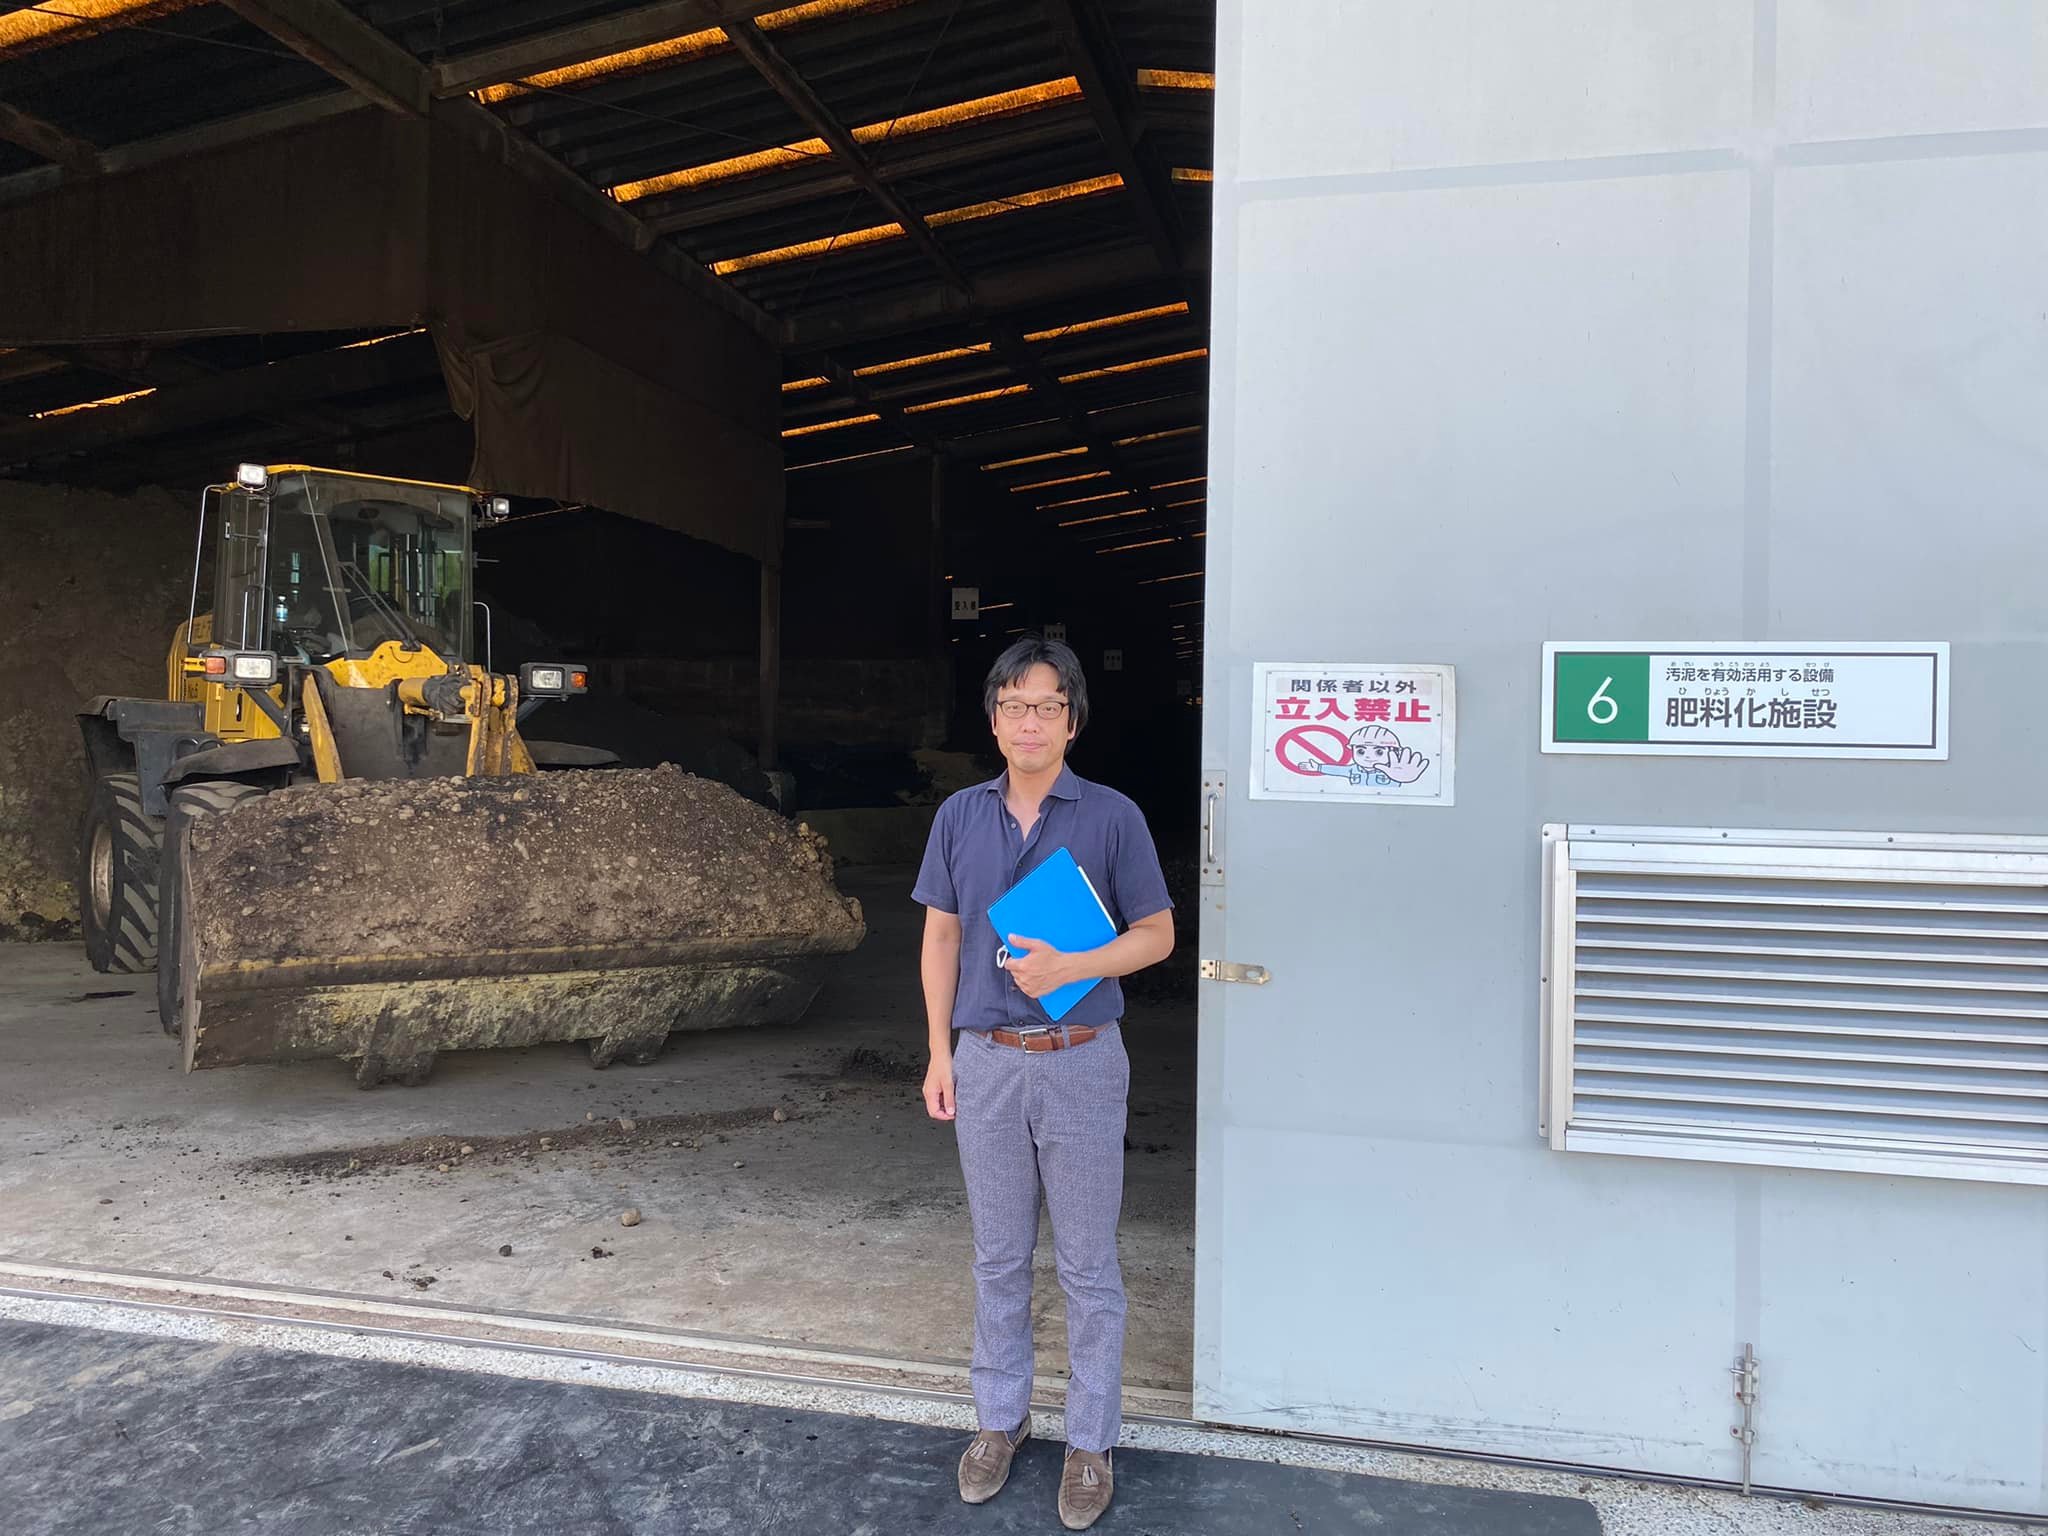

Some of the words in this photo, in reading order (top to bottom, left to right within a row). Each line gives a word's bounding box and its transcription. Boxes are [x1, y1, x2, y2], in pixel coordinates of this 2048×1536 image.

[1666, 667, 1834, 683] 汚泥を有効活用する設備
[1290, 679, 1417, 694] 関係者以外
[1704, 687, 1730, 696] りょう
[1746, 687, 1756, 696] か
[1781, 688, 1790, 696] し
[1811, 688, 1831, 696] せつ
[1275, 696, 1432, 722] 立入禁止
[1587, 676, 1619, 725] 6
[1665, 697, 1837, 729] 肥料化施設
